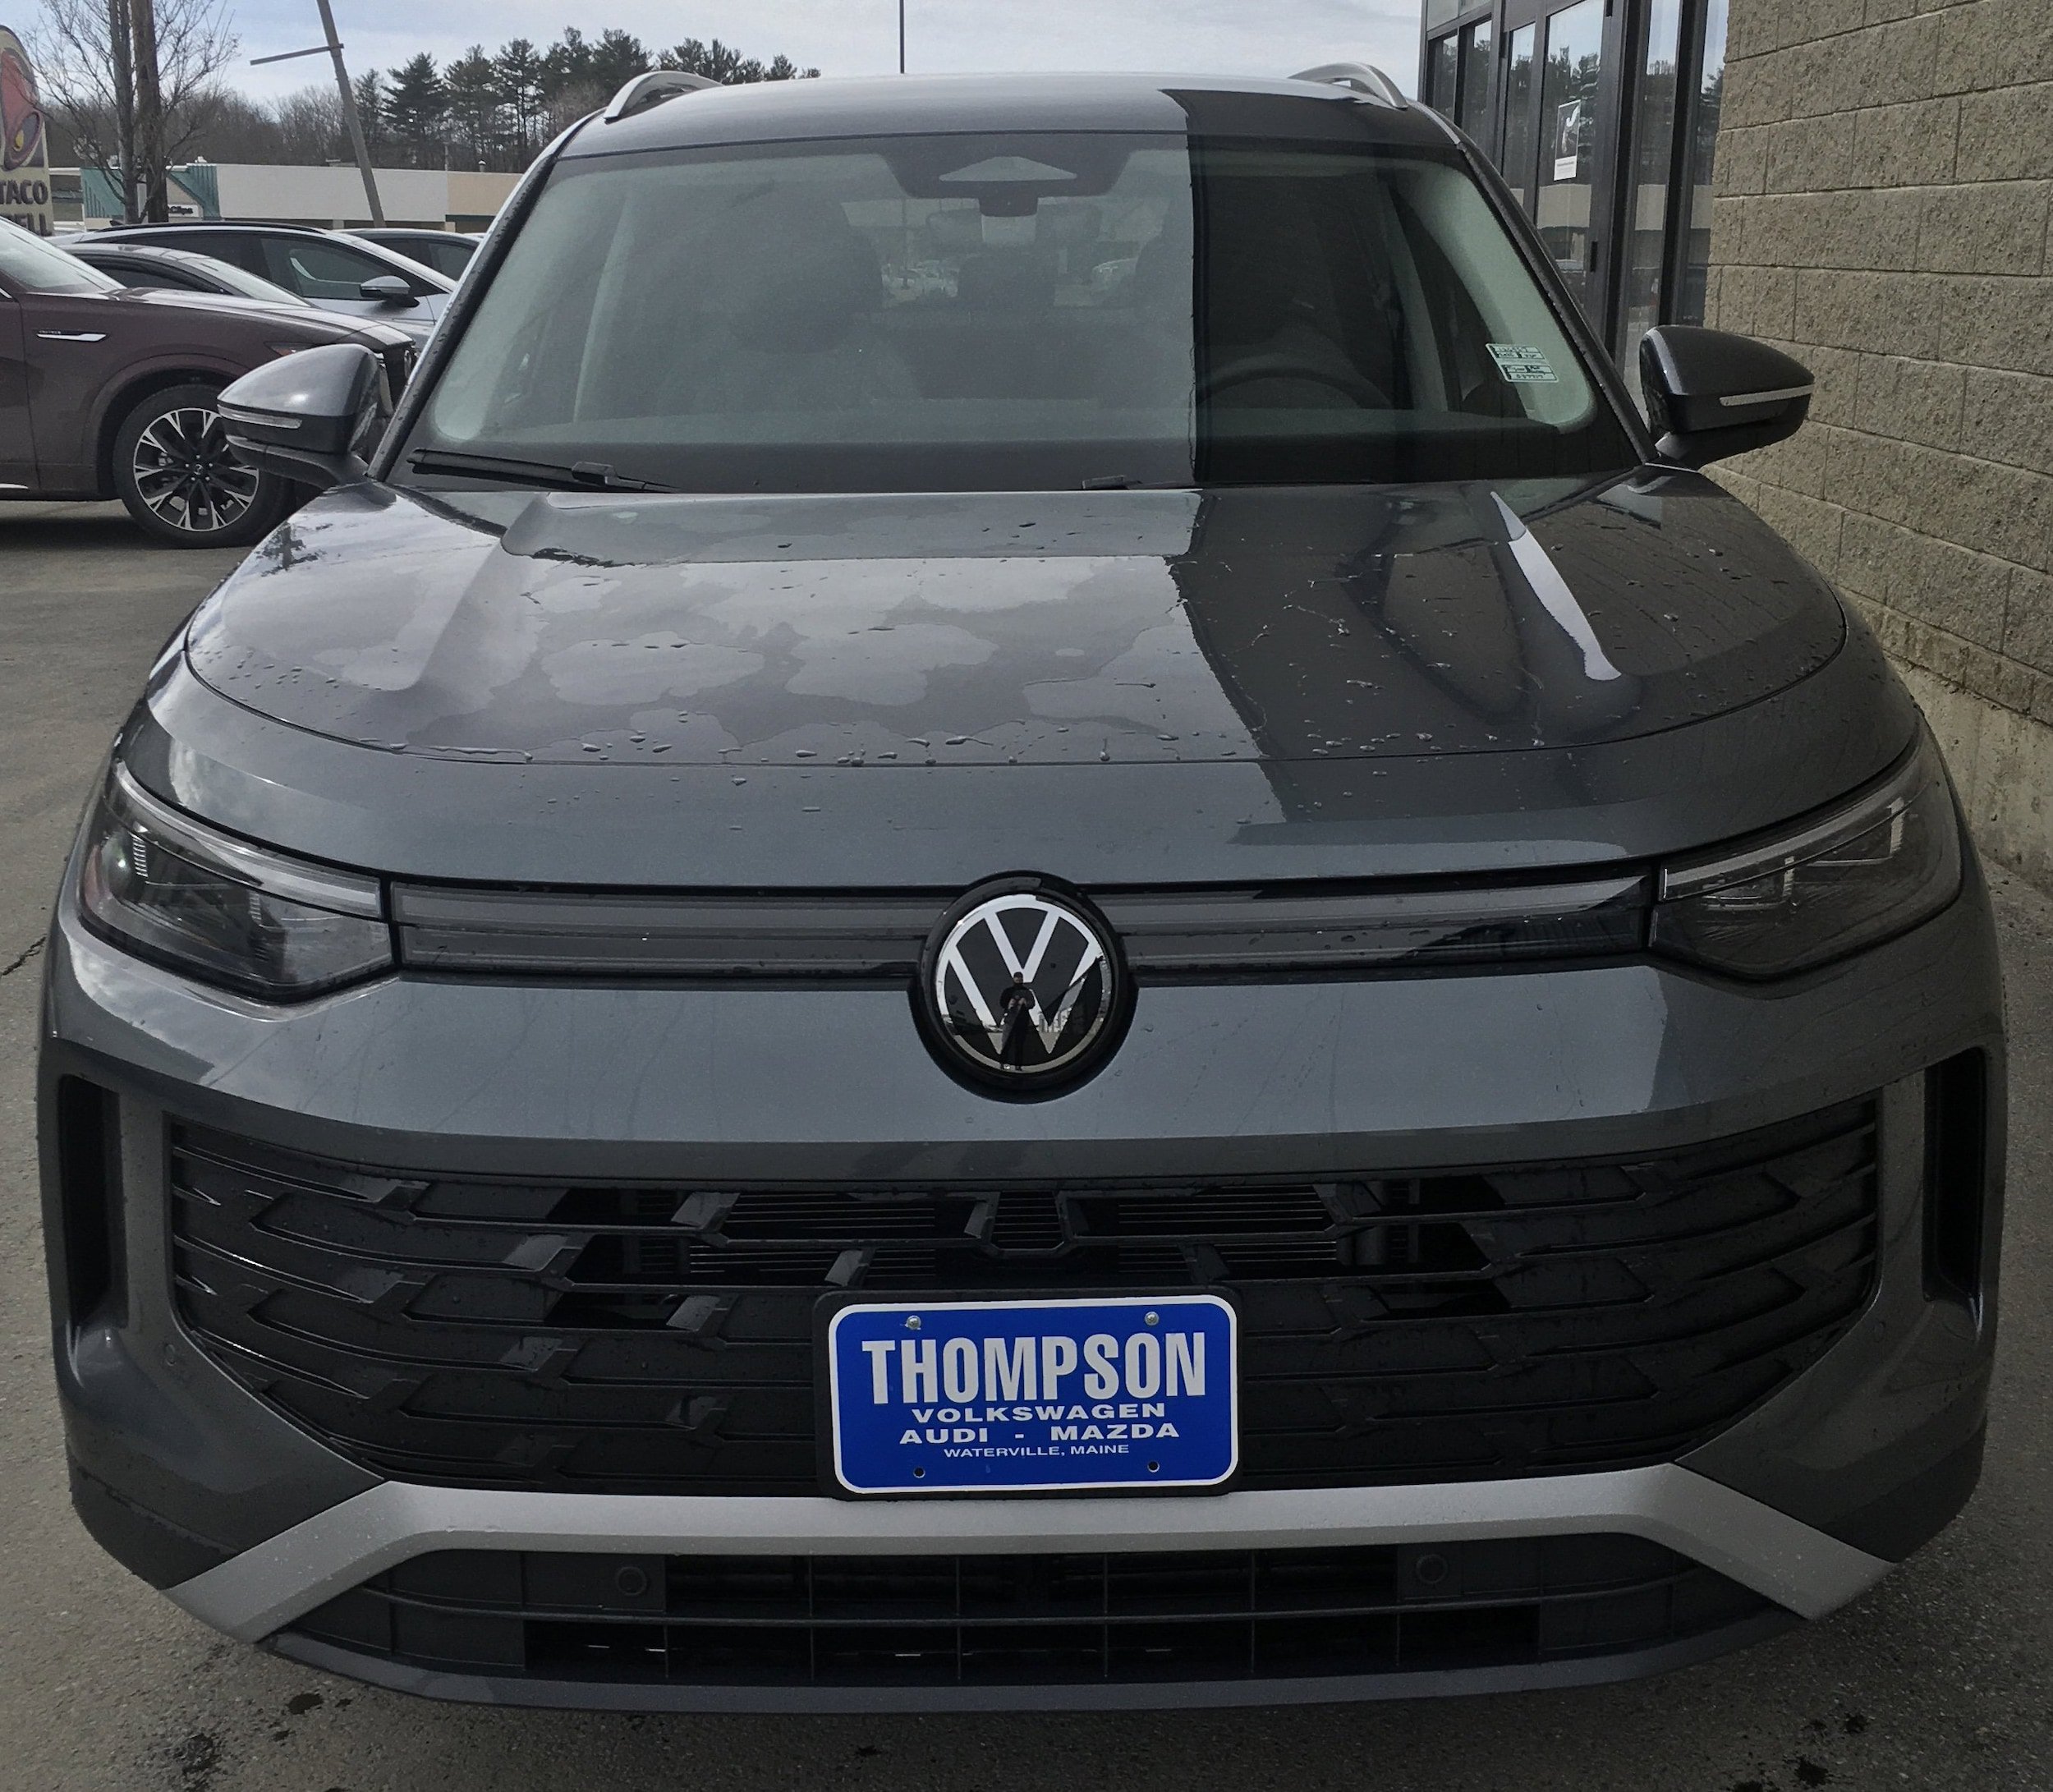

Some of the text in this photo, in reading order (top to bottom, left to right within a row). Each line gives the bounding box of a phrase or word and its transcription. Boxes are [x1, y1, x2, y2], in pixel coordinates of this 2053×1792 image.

[861, 1332, 1206, 1404] THOMPSON
[911, 1403, 1165, 1423] VOLKSWAGEN
[899, 1428, 988, 1445] AUDI
[1050, 1422, 1180, 1441] MAZDA
[944, 1444, 1130, 1458] WATERVILLE, MAINE
